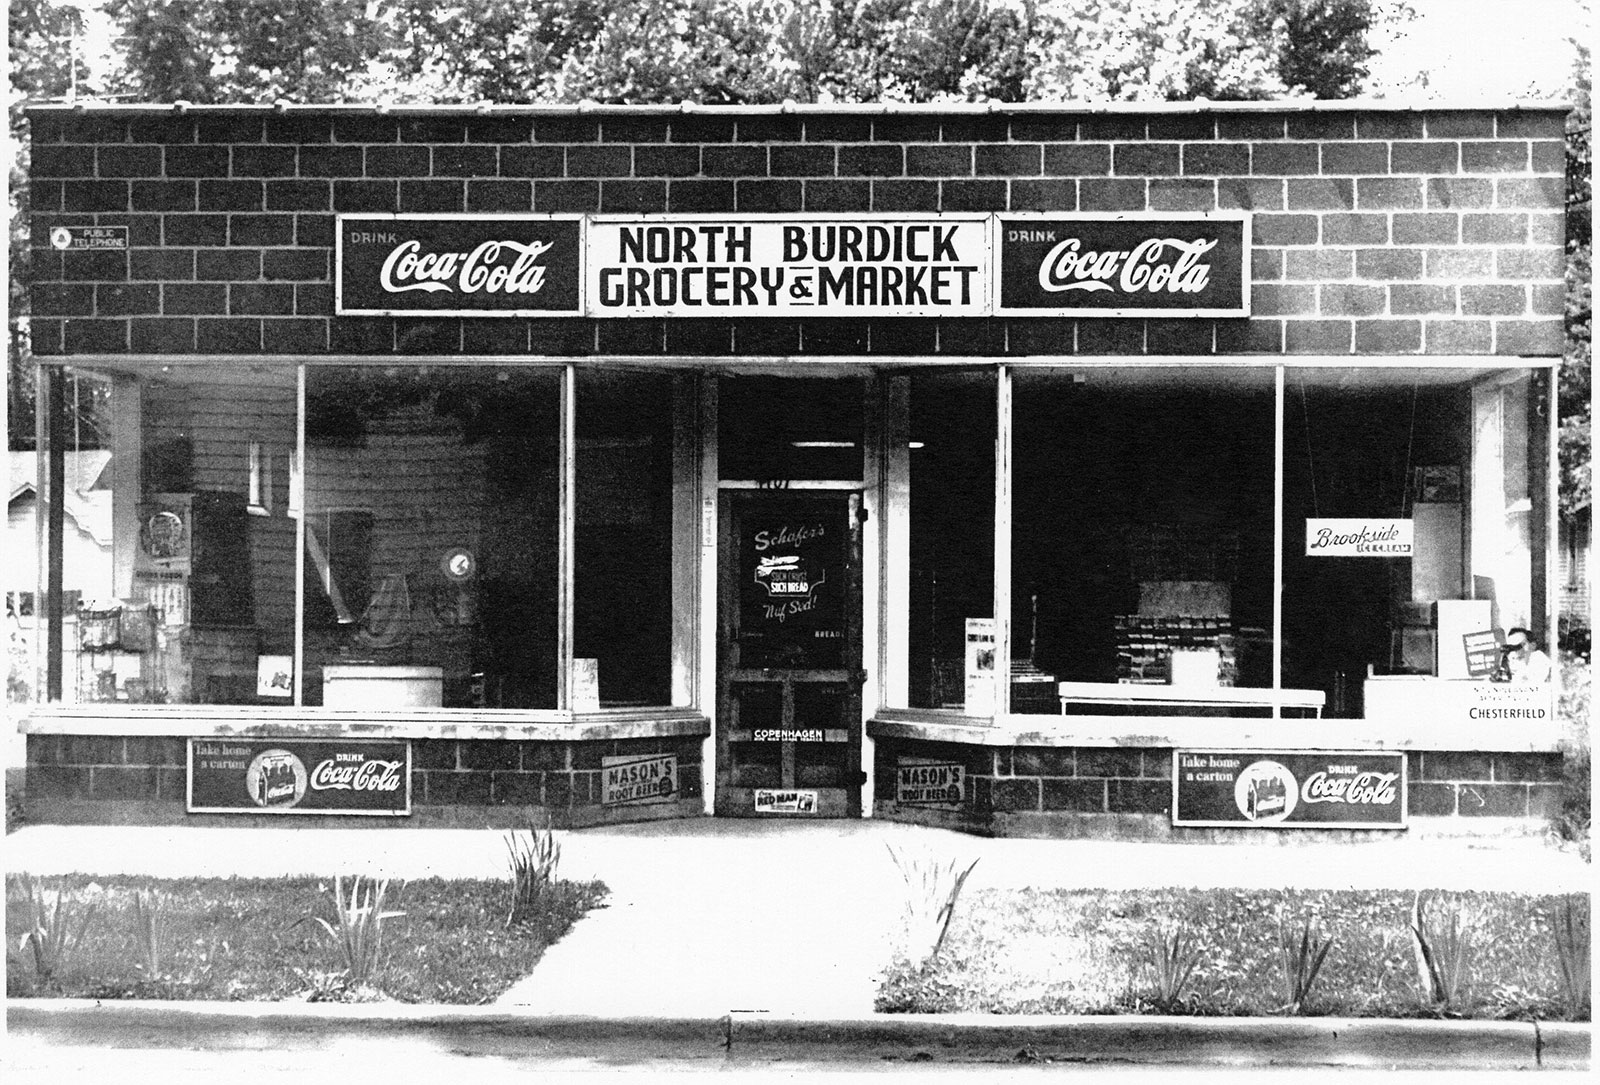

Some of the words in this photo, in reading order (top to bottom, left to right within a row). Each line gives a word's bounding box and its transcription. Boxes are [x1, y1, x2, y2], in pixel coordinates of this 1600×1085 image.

[83, 229, 115, 238] PUBLIC
[351, 232, 397, 244] DRINK
[1008, 230, 1056, 242] DRINK
[73, 238, 125, 247] TELEPHONE
[619, 226, 751, 263] NORTH
[782, 225, 960, 262] BURDICK
[380, 240, 554, 293] Coca-Cola
[1038, 238, 1219, 293] Coca-Cola
[600, 267, 785, 307] GROCERY
[789, 271, 814, 301] &
[818, 266, 978, 306] MARKET
[754, 523, 825, 550] Schafer's
[1310, 524, 1399, 549] Brookside
[770, 582, 787, 592] SUCH
[787, 582, 808, 593] BREAD
[762, 603, 787, 622] Nuf
[1469, 707, 1546, 719] CHESTERFIELD
[754, 729, 823, 738] COPENHAGEN
[196, 742, 220, 755] Take
[222, 744, 251, 755] home
[336, 753, 365, 762] DRINK
[1181, 755, 1207, 767] Take
[1209, 756, 1240, 767] home
[201, 761, 208, 769] a
[211, 760, 246, 769] carton
[1328, 765, 1358, 774] DRINK
[310, 759, 404, 791] Coca-Cola
[609, 760, 672, 785] MASON'S
[902, 765, 960, 785] MASON'S
[1196, 772, 1234, 781] carton
[609, 787, 633, 801] ROOT
[636, 783, 659, 796] BEER
[1301, 772, 1400, 804] Coca-Cola
[757, 795, 776, 806] RED
[777, 793, 798, 804] MAN
